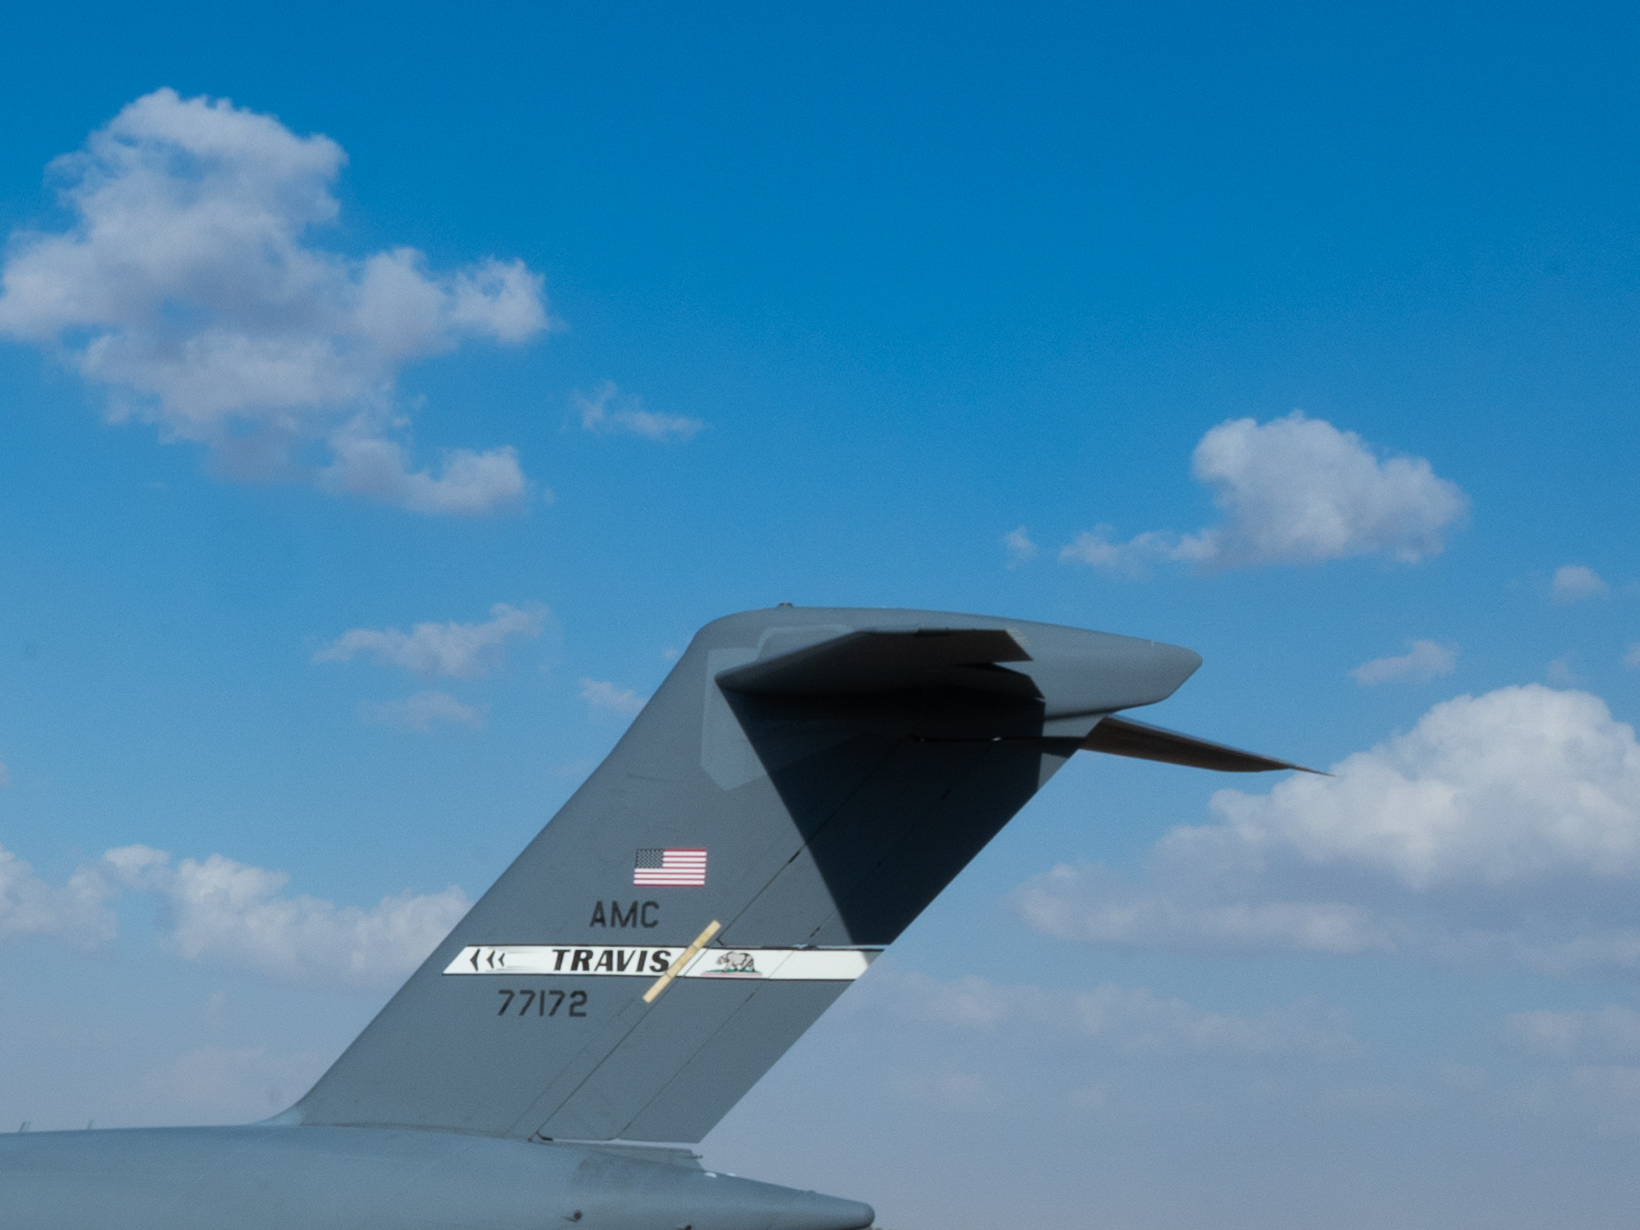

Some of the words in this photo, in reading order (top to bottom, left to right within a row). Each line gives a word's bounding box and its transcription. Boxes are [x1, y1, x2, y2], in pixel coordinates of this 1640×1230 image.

[589, 900, 660, 928] AMC
[552, 948, 671, 973] TRAVIS
[497, 989, 588, 1017] 77172
